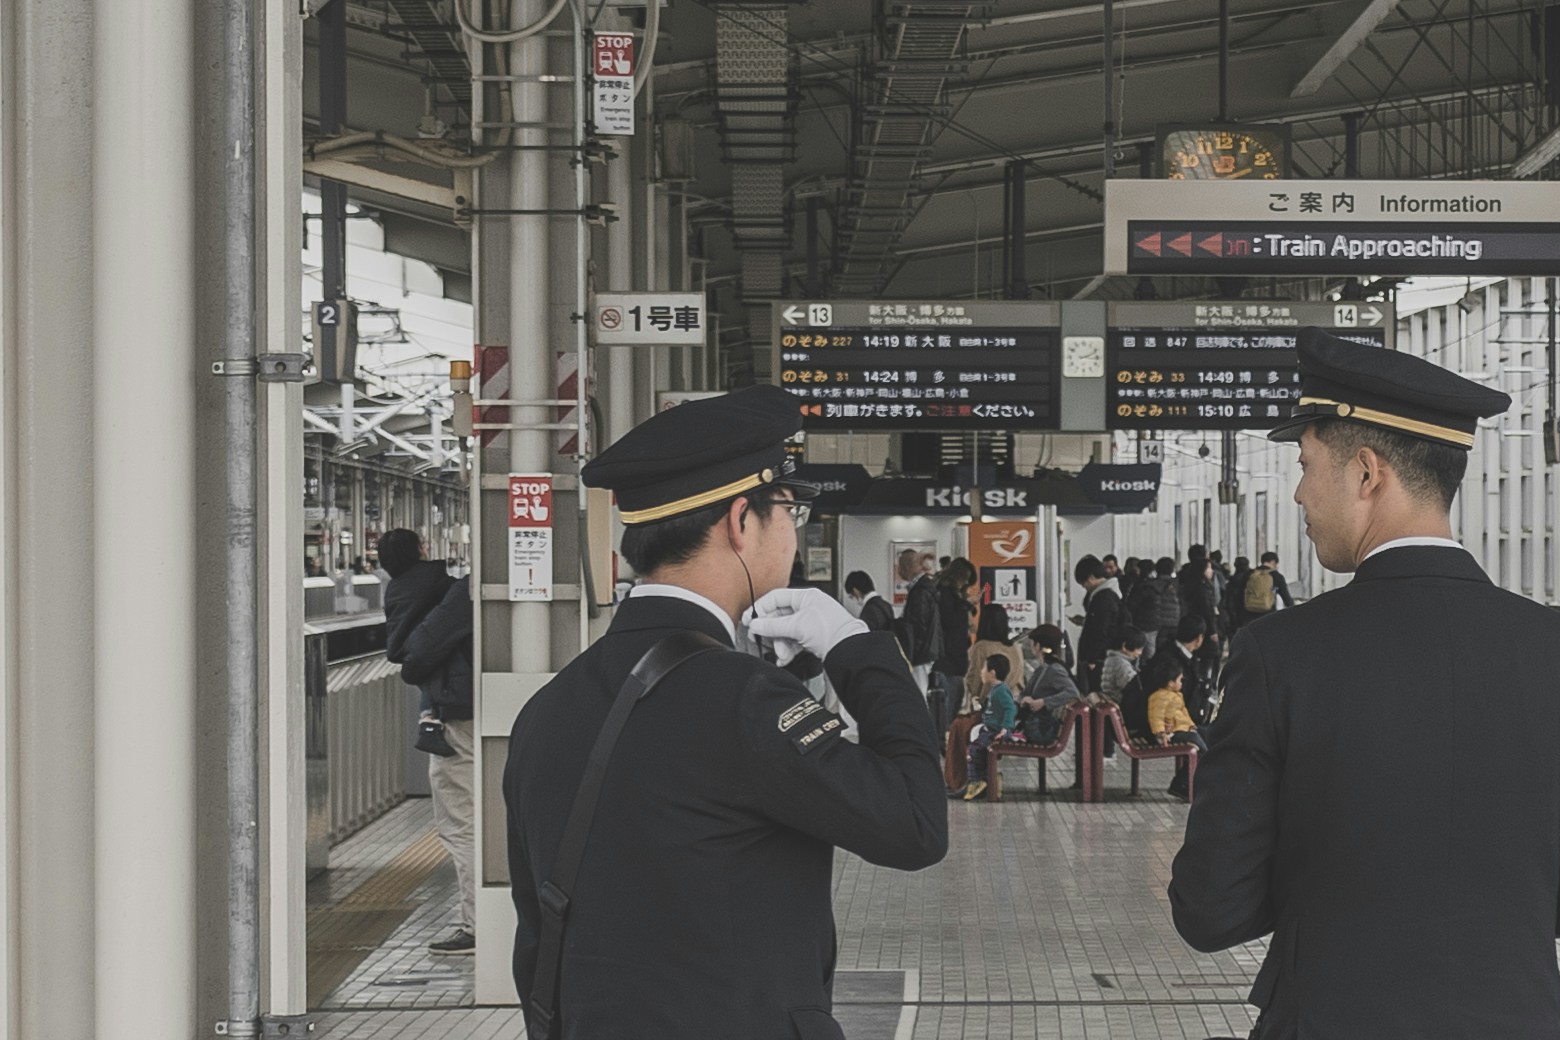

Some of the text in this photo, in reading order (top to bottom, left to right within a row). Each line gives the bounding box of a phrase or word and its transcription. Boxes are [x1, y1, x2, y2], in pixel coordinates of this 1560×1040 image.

[597, 36, 633, 49] STOP
[1269, 192, 1502, 213] ご案内 Information
[1264, 233, 1326, 257] Train
[1330, 234, 1482, 260] Approaching
[322, 306, 336, 324] 2
[628, 305, 700, 332] 1号車
[812, 307, 829, 323] 13
[1338, 309, 1354, 324] 14
[782, 334, 828, 348] のぞみ
[832, 336, 852, 347] 227
[863, 335, 900, 347] 14:19
[1166, 336, 1188, 347] 847
[782, 369, 828, 383] のぞみ
[836, 371, 849, 382] 31
[863, 370, 899, 383] 14:24
[1117, 370, 1163, 383] のぞみ
[1198, 371, 1234, 383] 14:49
[1117, 403, 1163, 417] のぞみ
[1168, 405, 1187, 416] 111
[1198, 404, 1234, 417] 15:10
[1144, 445, 1159, 459] 14
[512, 483, 550, 495] STOP
[1101, 480, 1156, 491] Kiosk
